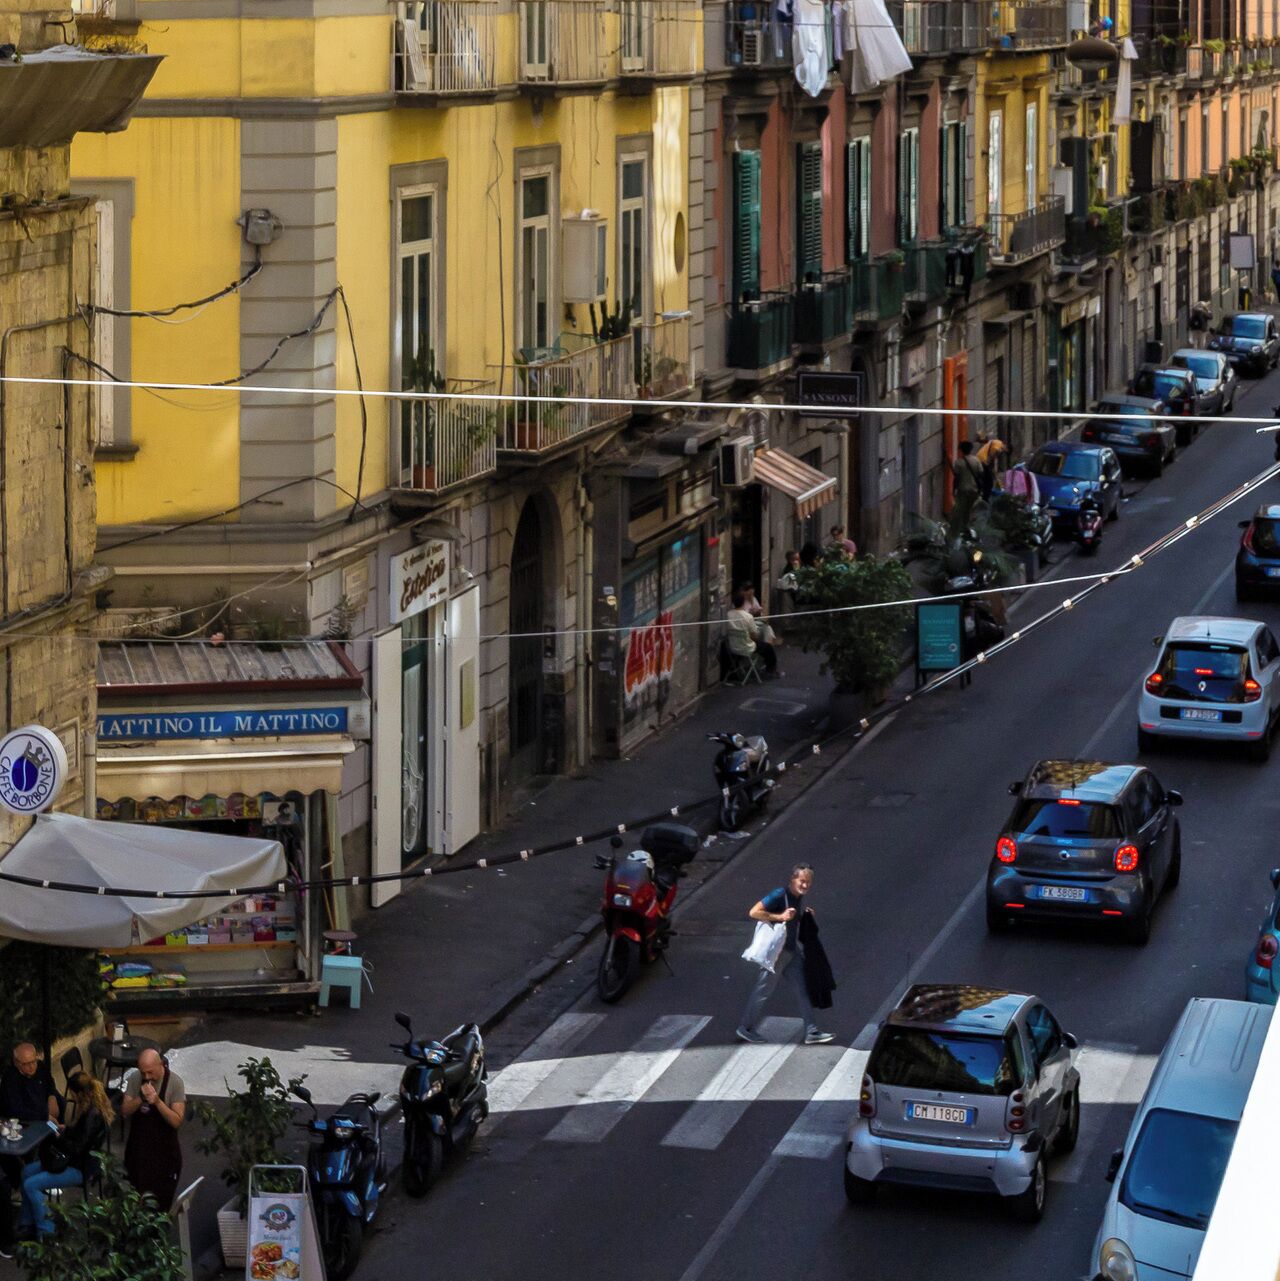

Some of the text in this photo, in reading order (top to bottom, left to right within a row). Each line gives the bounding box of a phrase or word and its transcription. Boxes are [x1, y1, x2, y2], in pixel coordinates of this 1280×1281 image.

[200, 716, 222, 732] IL
[234, 713, 340, 732] MATTINO
[10, 765, 53, 808] BORBONE
[914, 1105, 965, 1121] CM 118GD
